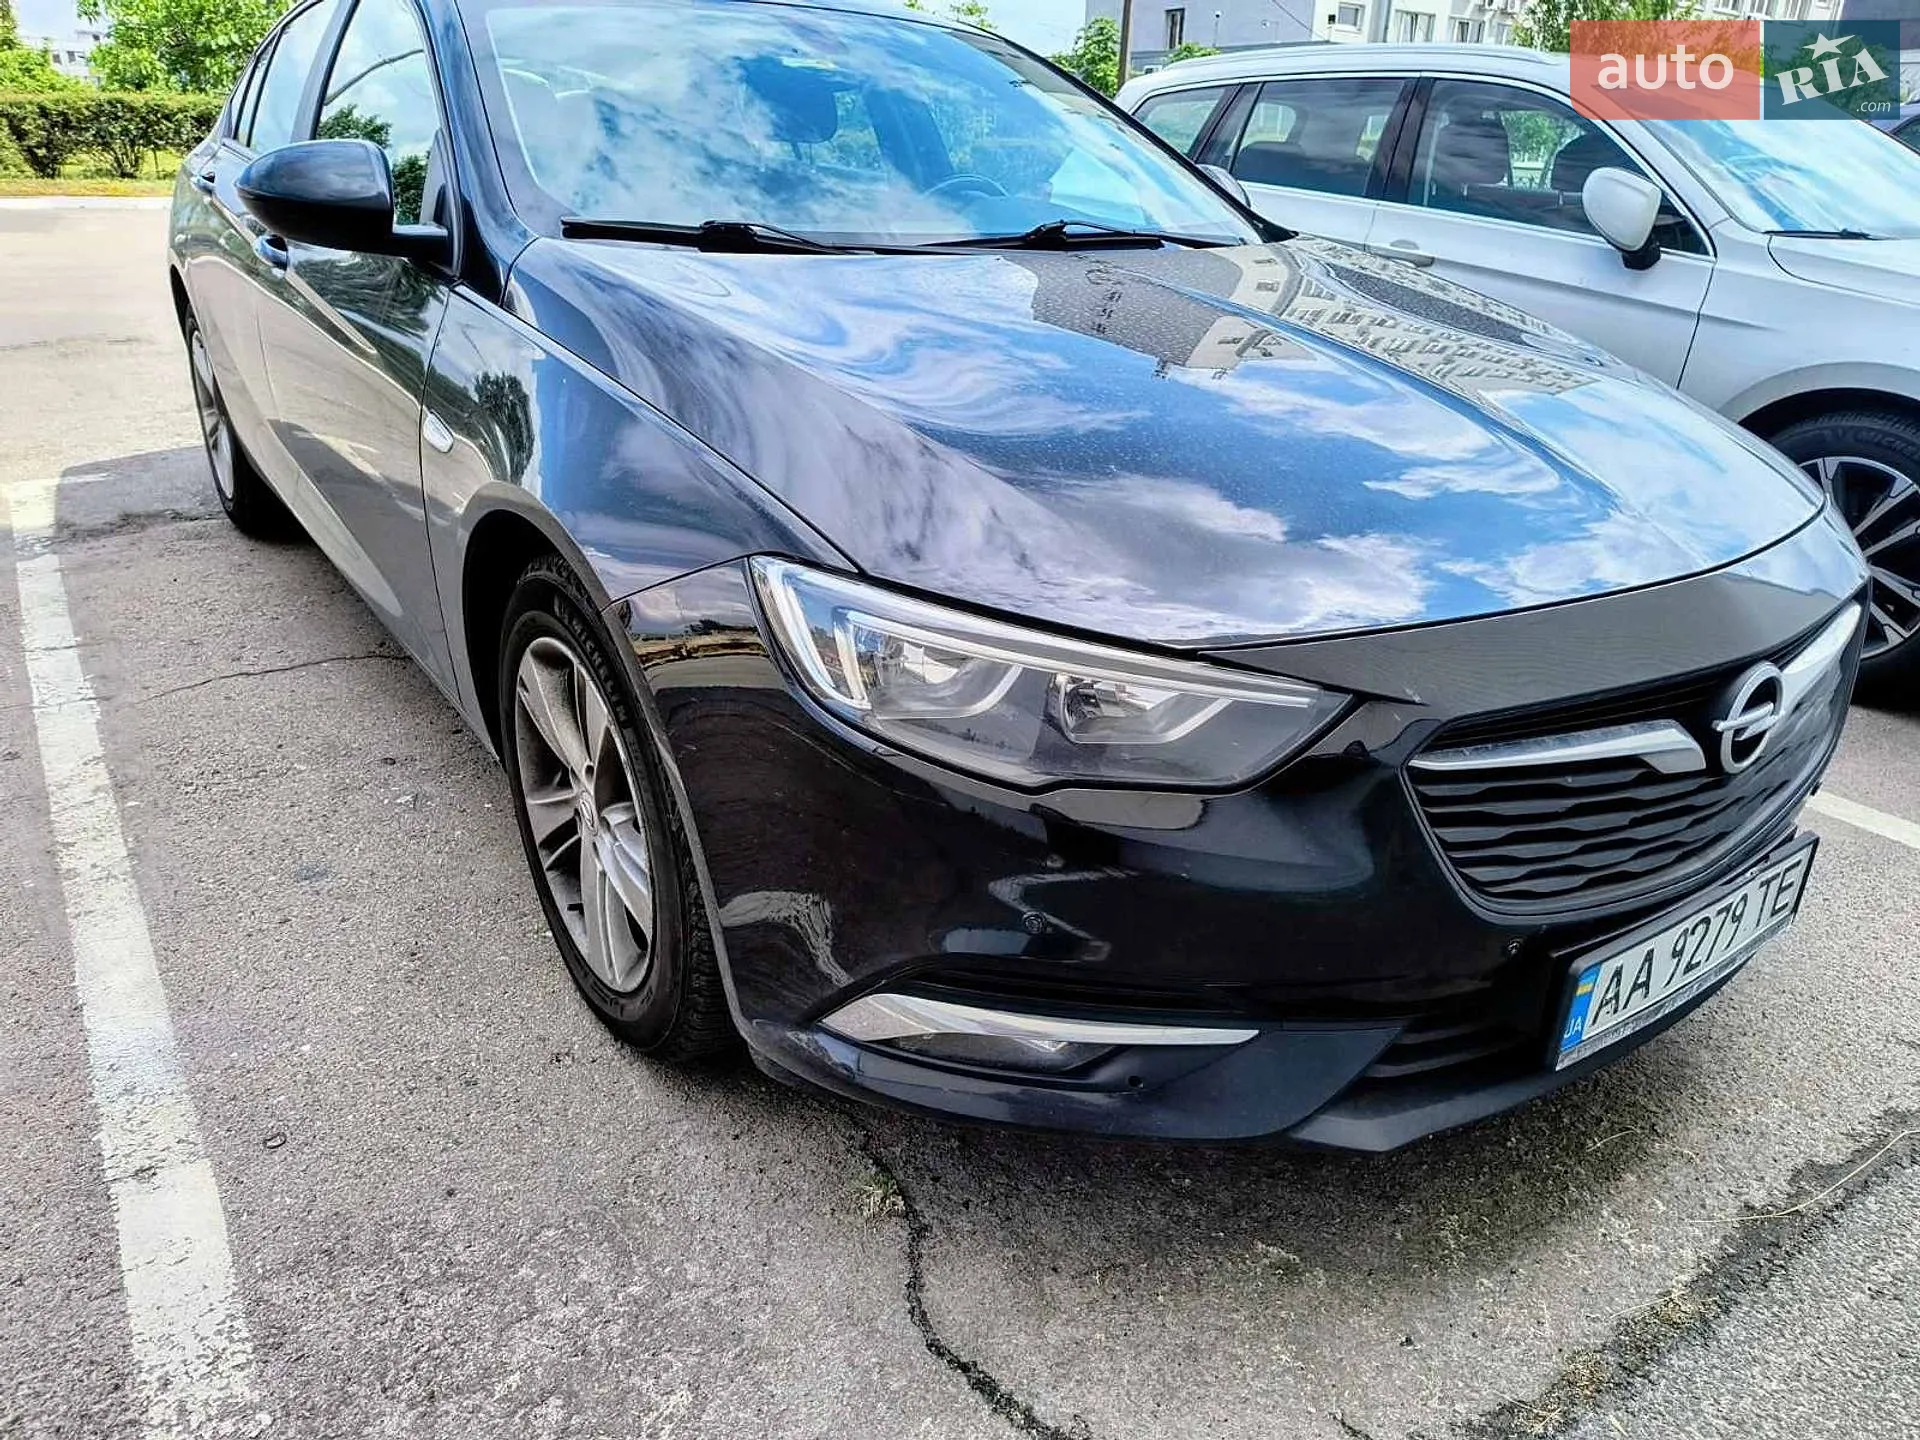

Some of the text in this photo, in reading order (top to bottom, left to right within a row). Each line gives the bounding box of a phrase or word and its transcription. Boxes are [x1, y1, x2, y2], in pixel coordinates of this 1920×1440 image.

[1591, 948, 1655, 1026] AA
[1664, 892, 1749, 988] 9279
[1756, 858, 1802, 928] TE
